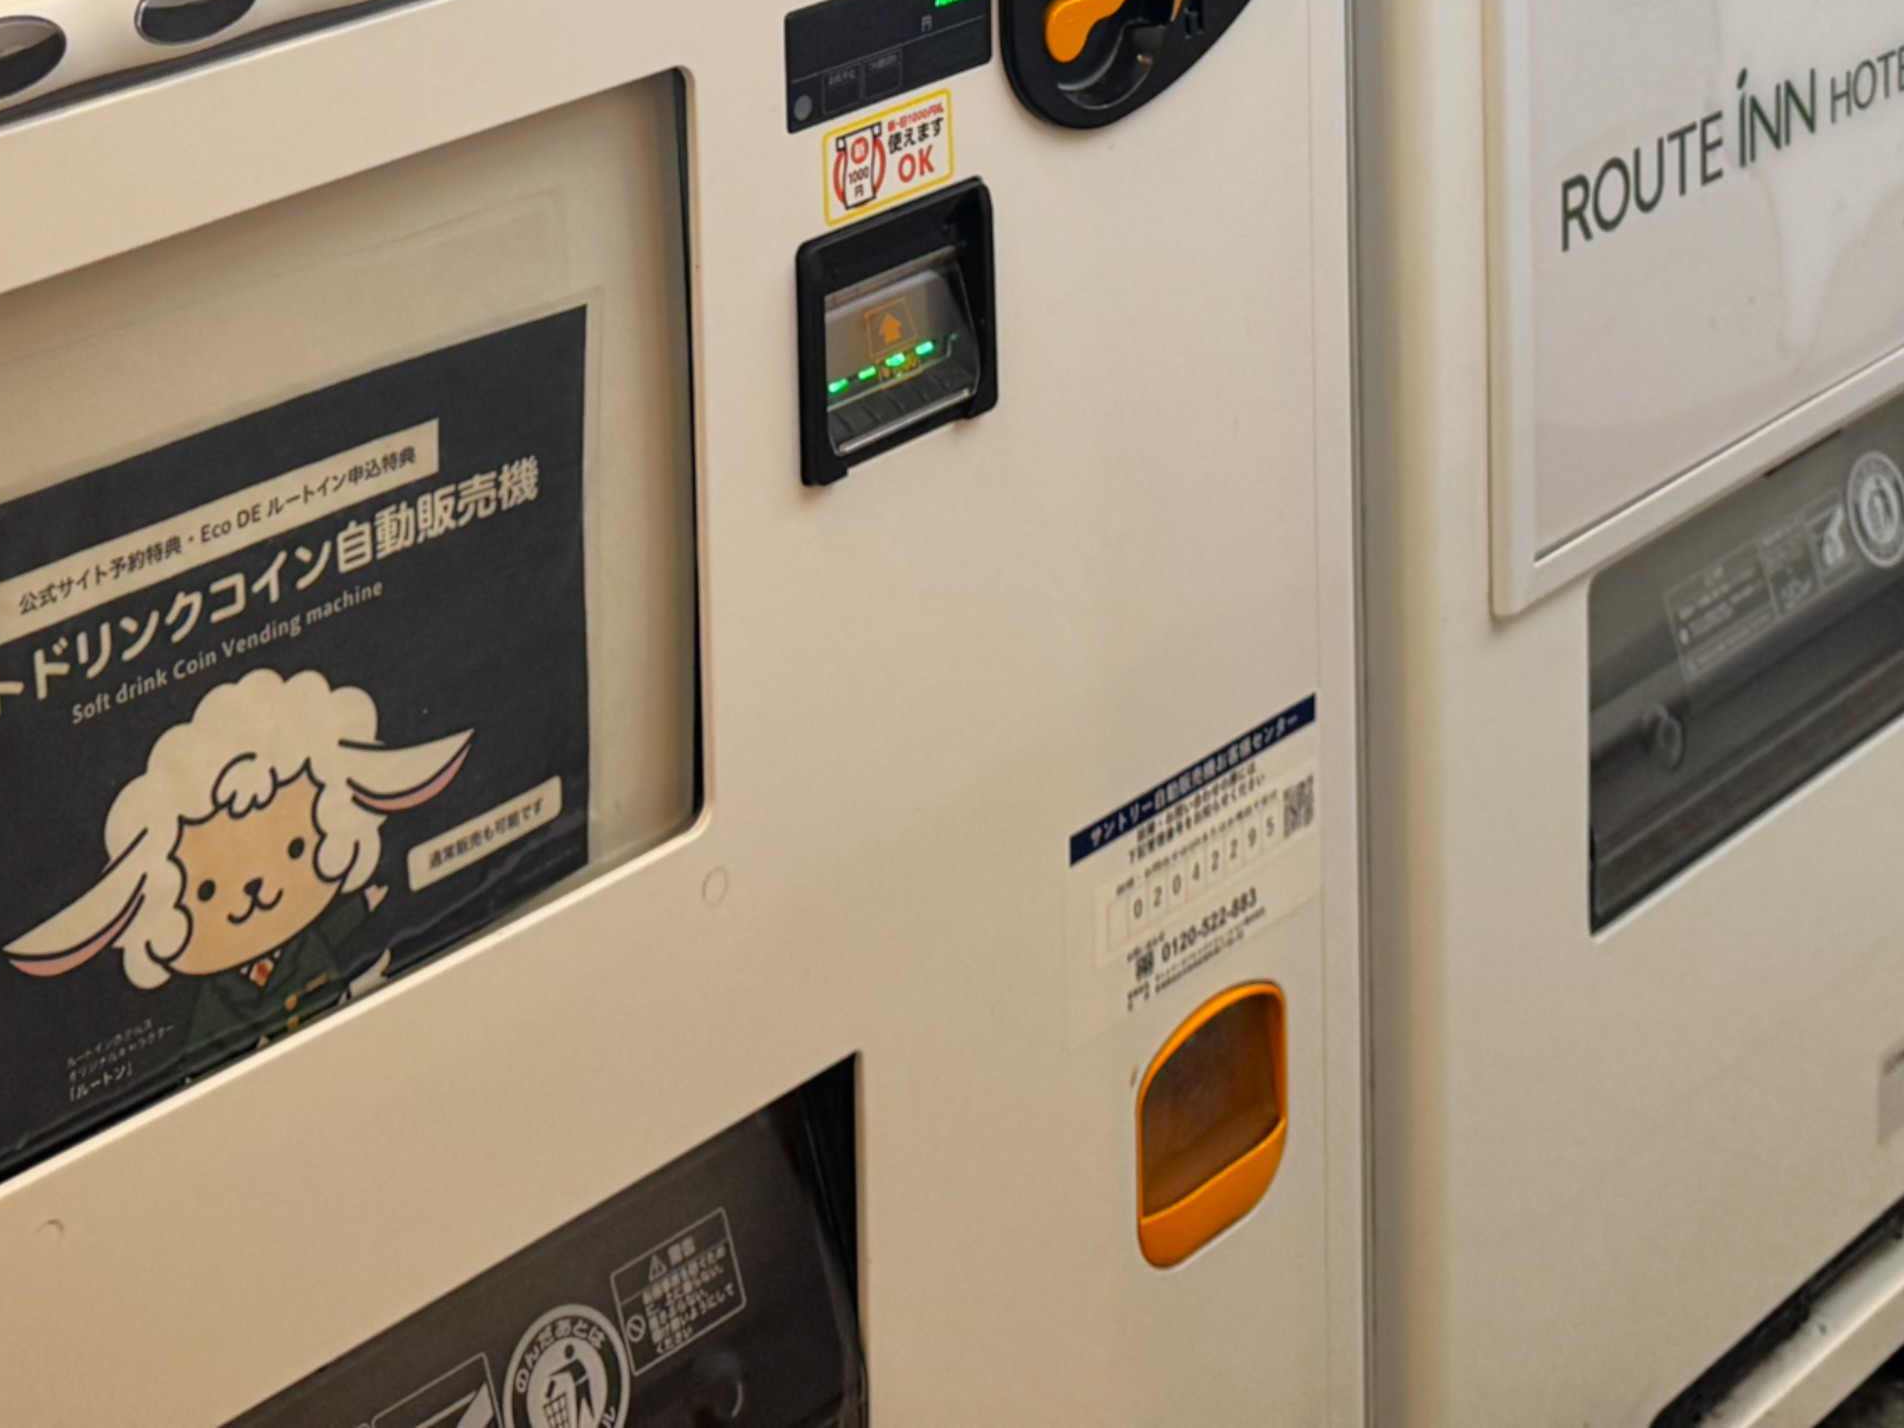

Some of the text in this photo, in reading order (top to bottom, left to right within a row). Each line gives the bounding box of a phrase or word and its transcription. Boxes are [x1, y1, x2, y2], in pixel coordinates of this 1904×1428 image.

[887, 116, 943, 154] 使えます
[897, 145, 935, 183] OK
[848, 167, 870, 184] 1000
[1561, 110, 1724, 254] ROUTE
[18, 444, 418, 617] 公式サイト予約特典 Eco DE ルートイン申込特典
[71, 579, 384, 727] Soft drink Coin Vending machine
[516, 1318, 608, 1393] のんだあとは
